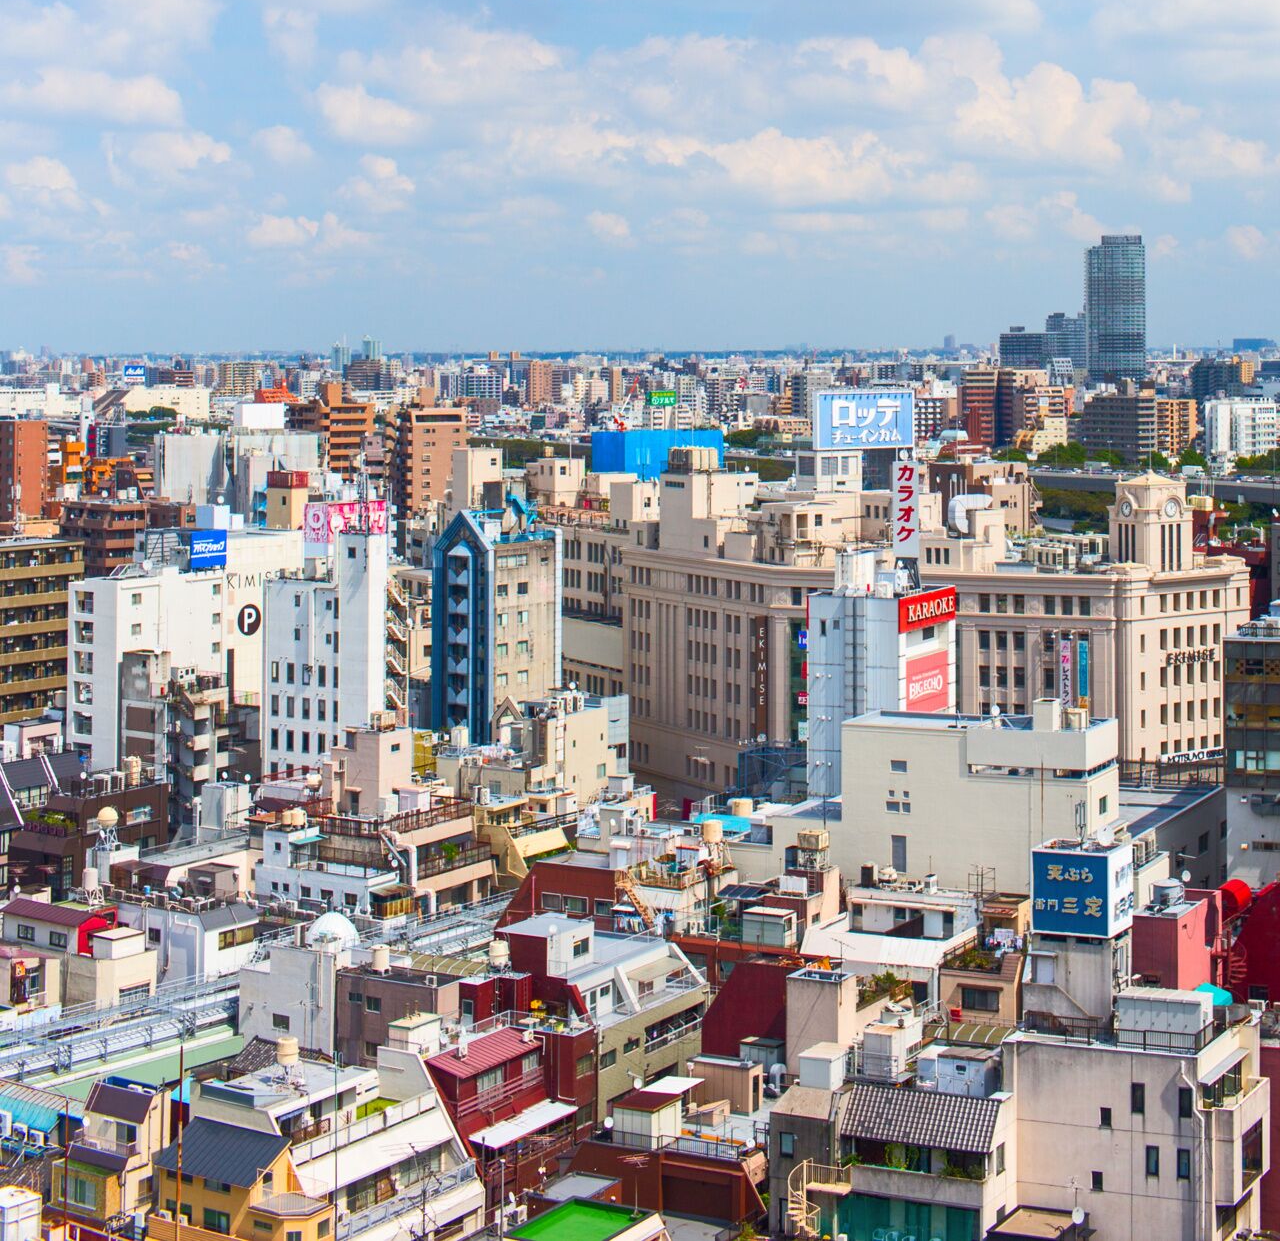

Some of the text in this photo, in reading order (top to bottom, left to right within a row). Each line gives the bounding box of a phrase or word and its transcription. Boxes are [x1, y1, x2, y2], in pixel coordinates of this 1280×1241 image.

[832, 399, 900, 427] ロッテ
[832, 428, 902, 444] チューインガム
[897, 465, 915, 543] カラオケ
[243, 607, 257, 633] P
[907, 595, 954, 622] KARAOKE
[757, 627, 767, 705] EKIMISE
[1166, 648, 1216, 667] EKIMISE
[909, 682, 923, 700] BIG
[923, 674, 943, 691] ECHO
[1062, 666, 1070, 705] レストラン
[1046, 864, 1094, 883] 天ぷら
[1034, 895, 1103, 918] 雷門 三定
